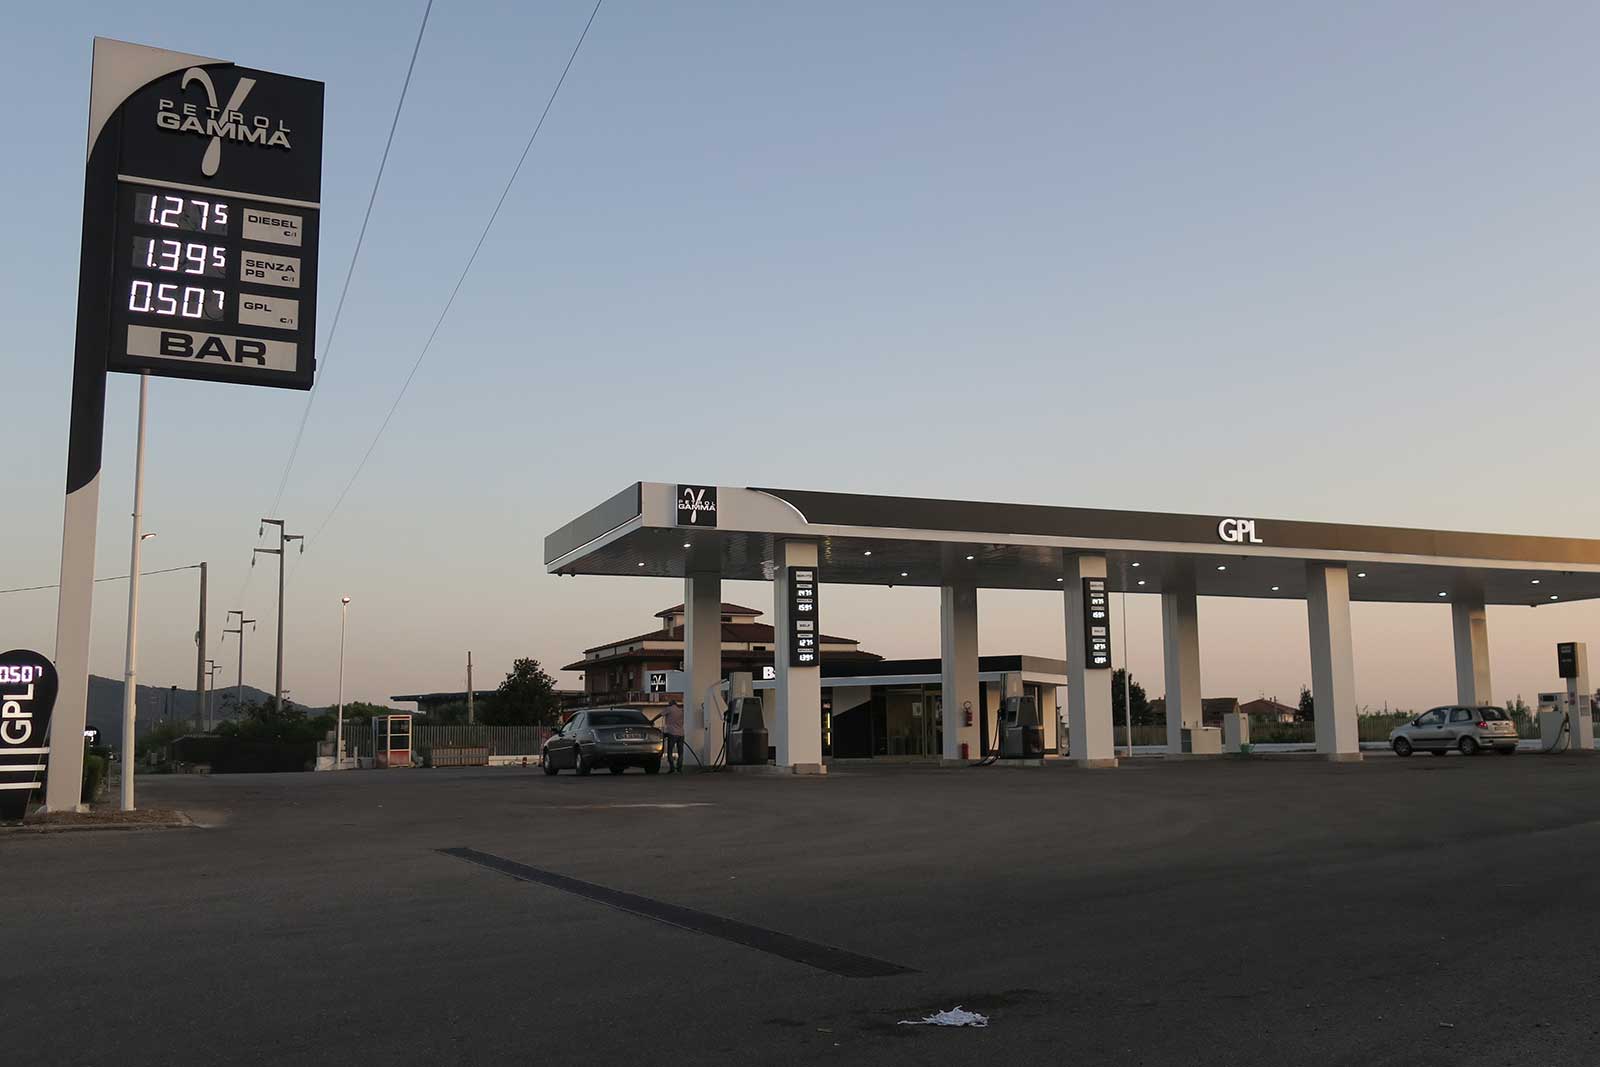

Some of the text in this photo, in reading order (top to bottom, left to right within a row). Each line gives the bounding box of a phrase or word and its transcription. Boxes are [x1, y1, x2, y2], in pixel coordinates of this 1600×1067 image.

[159, 98, 291, 132] PETROL
[156, 111, 291, 149] GAMMA
[247, 215, 298, 229] DIESEL
[245, 259, 296, 273] SENZA
[243, 301, 272, 313] GPL
[159, 330, 267, 366] BAR
[678, 503, 717, 512] GAMMA
[1218, 518, 1263, 543] GPL
[0, 684, 34, 744] GPL
